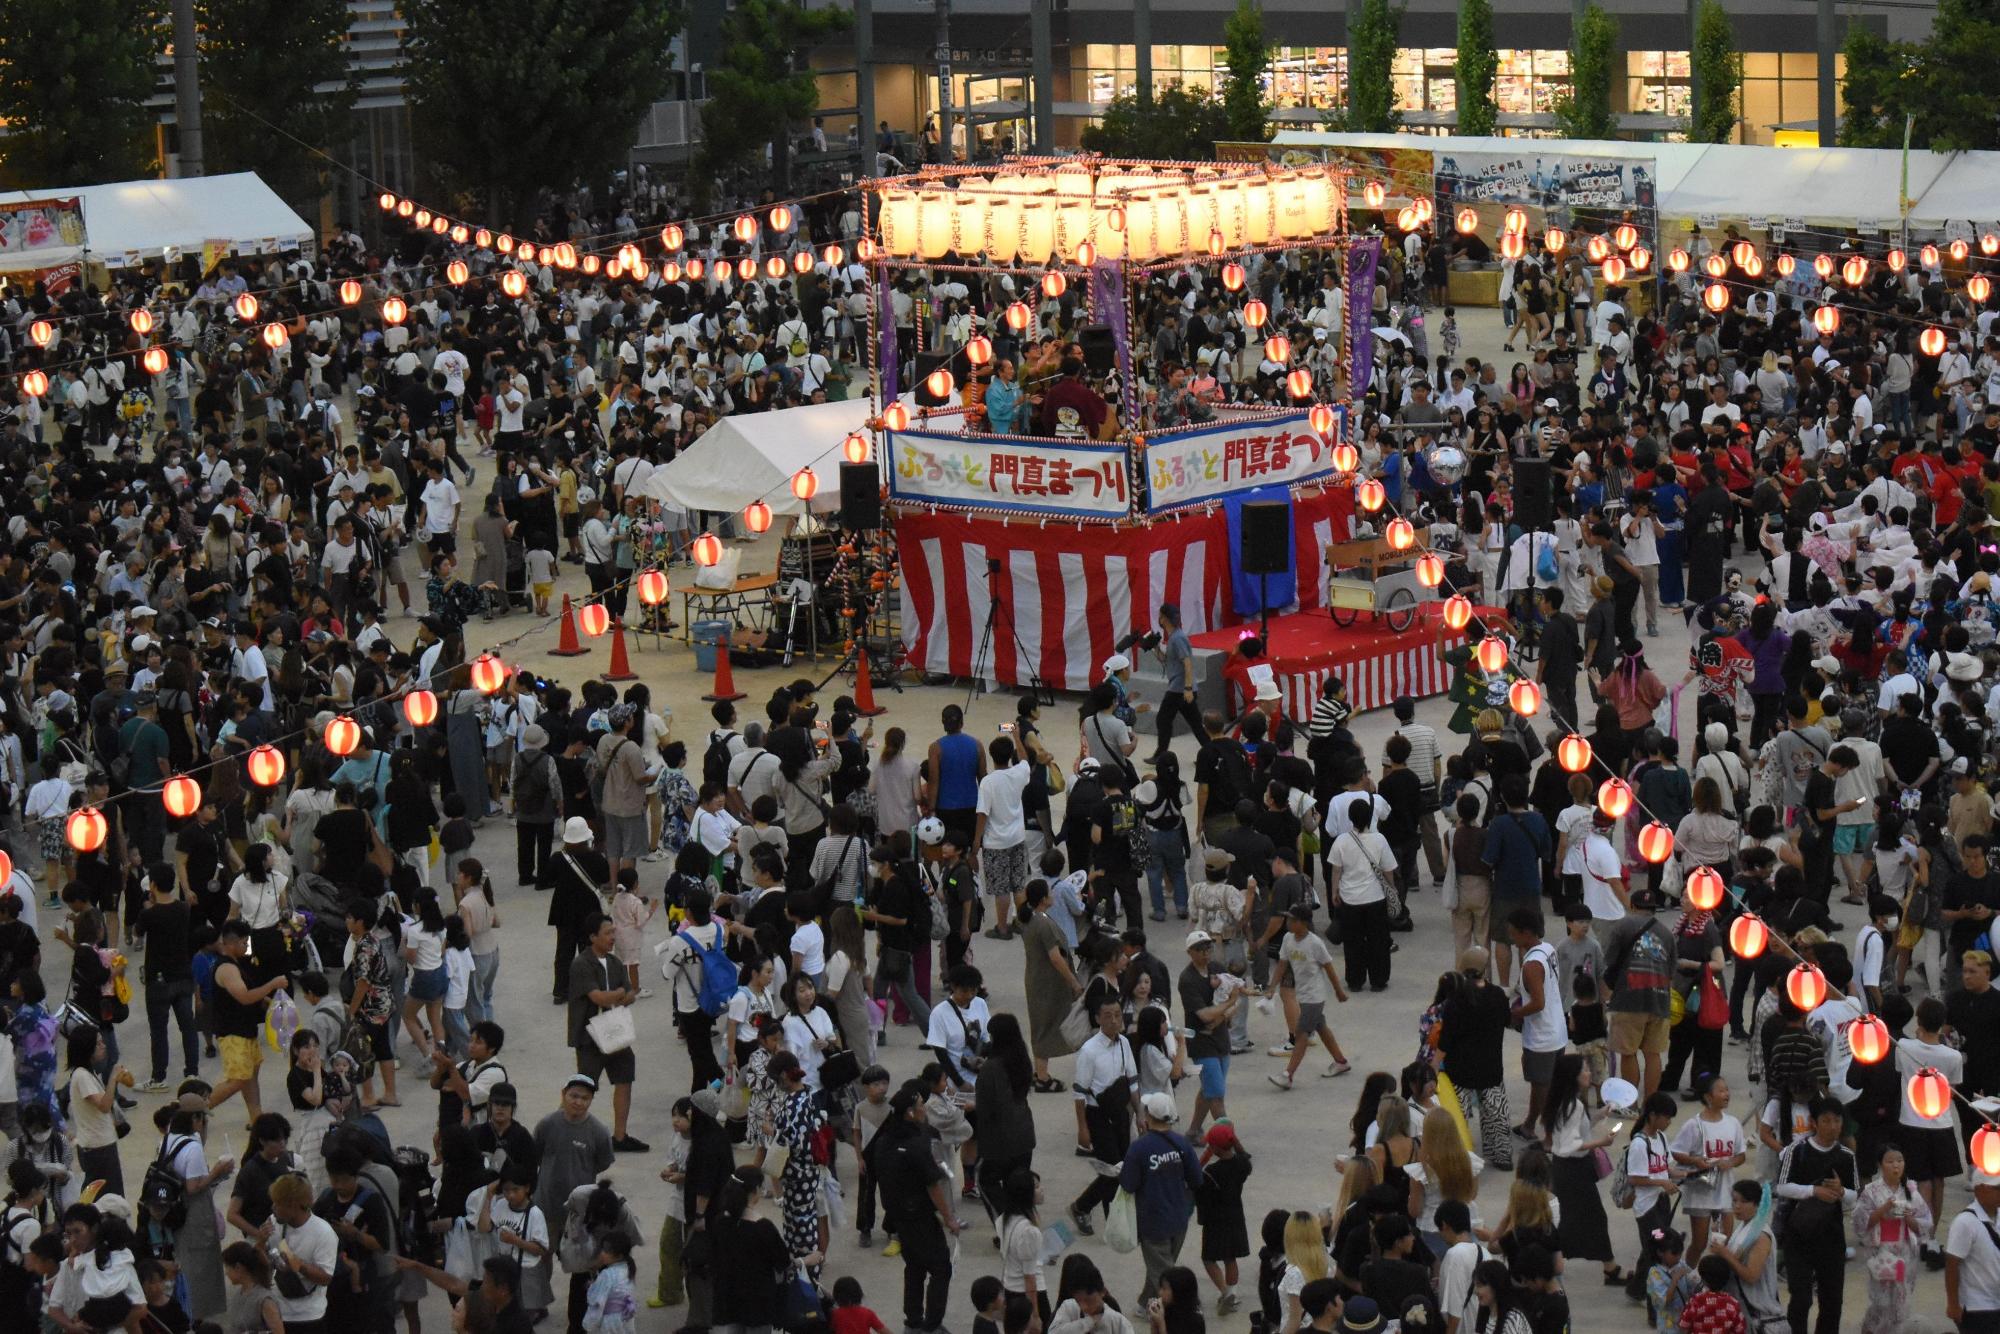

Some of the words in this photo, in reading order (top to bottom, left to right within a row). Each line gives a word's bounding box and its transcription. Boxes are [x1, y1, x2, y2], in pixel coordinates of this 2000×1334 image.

[1481, 165, 1498, 177] WE
[1568, 163, 1583, 173] WE
[1477, 184, 1494, 198] WE
[1568, 193, 1583, 203] WE
[1379, 550, 1403, 561] MOBILE
